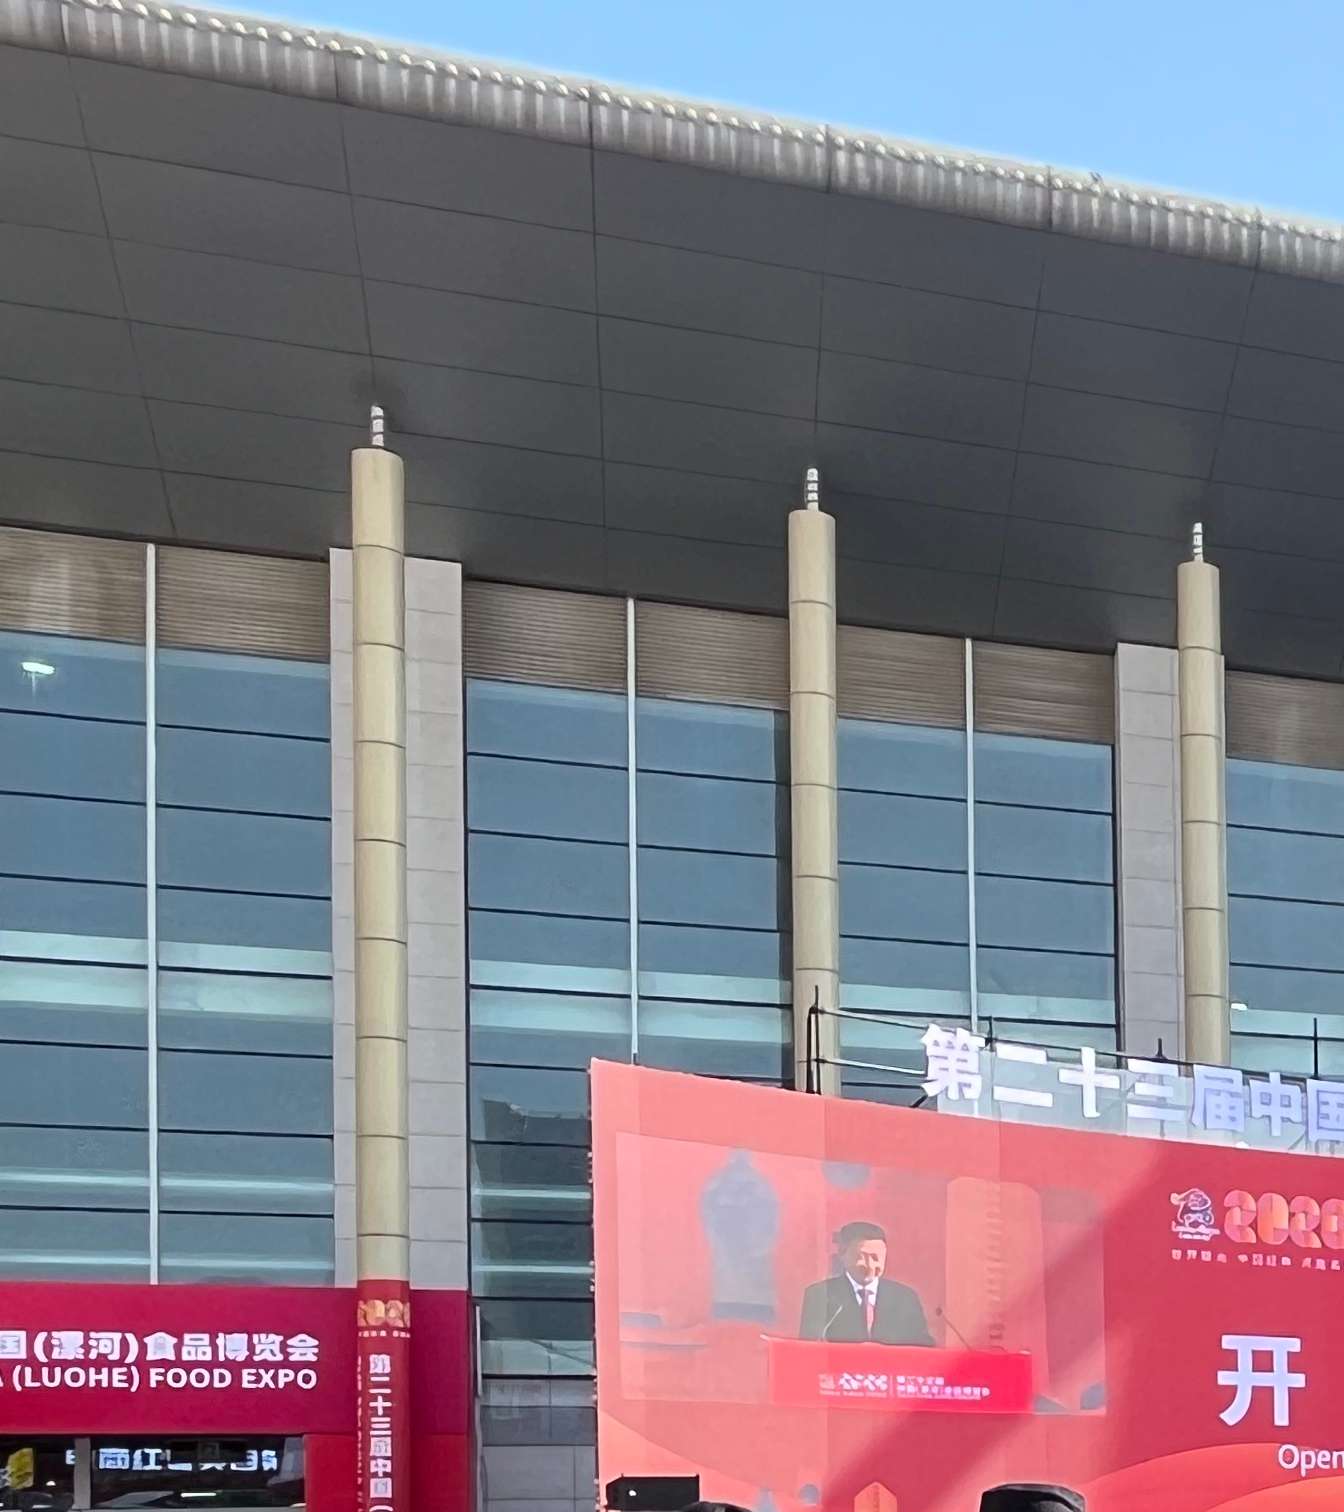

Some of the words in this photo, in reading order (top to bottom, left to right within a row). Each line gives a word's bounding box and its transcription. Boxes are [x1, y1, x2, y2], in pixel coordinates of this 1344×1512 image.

[12, 1364, 141, 1393] (LUOHE)
[149, 1367, 233, 1389] FOOD
[241, 1368, 318, 1390] EXPO
